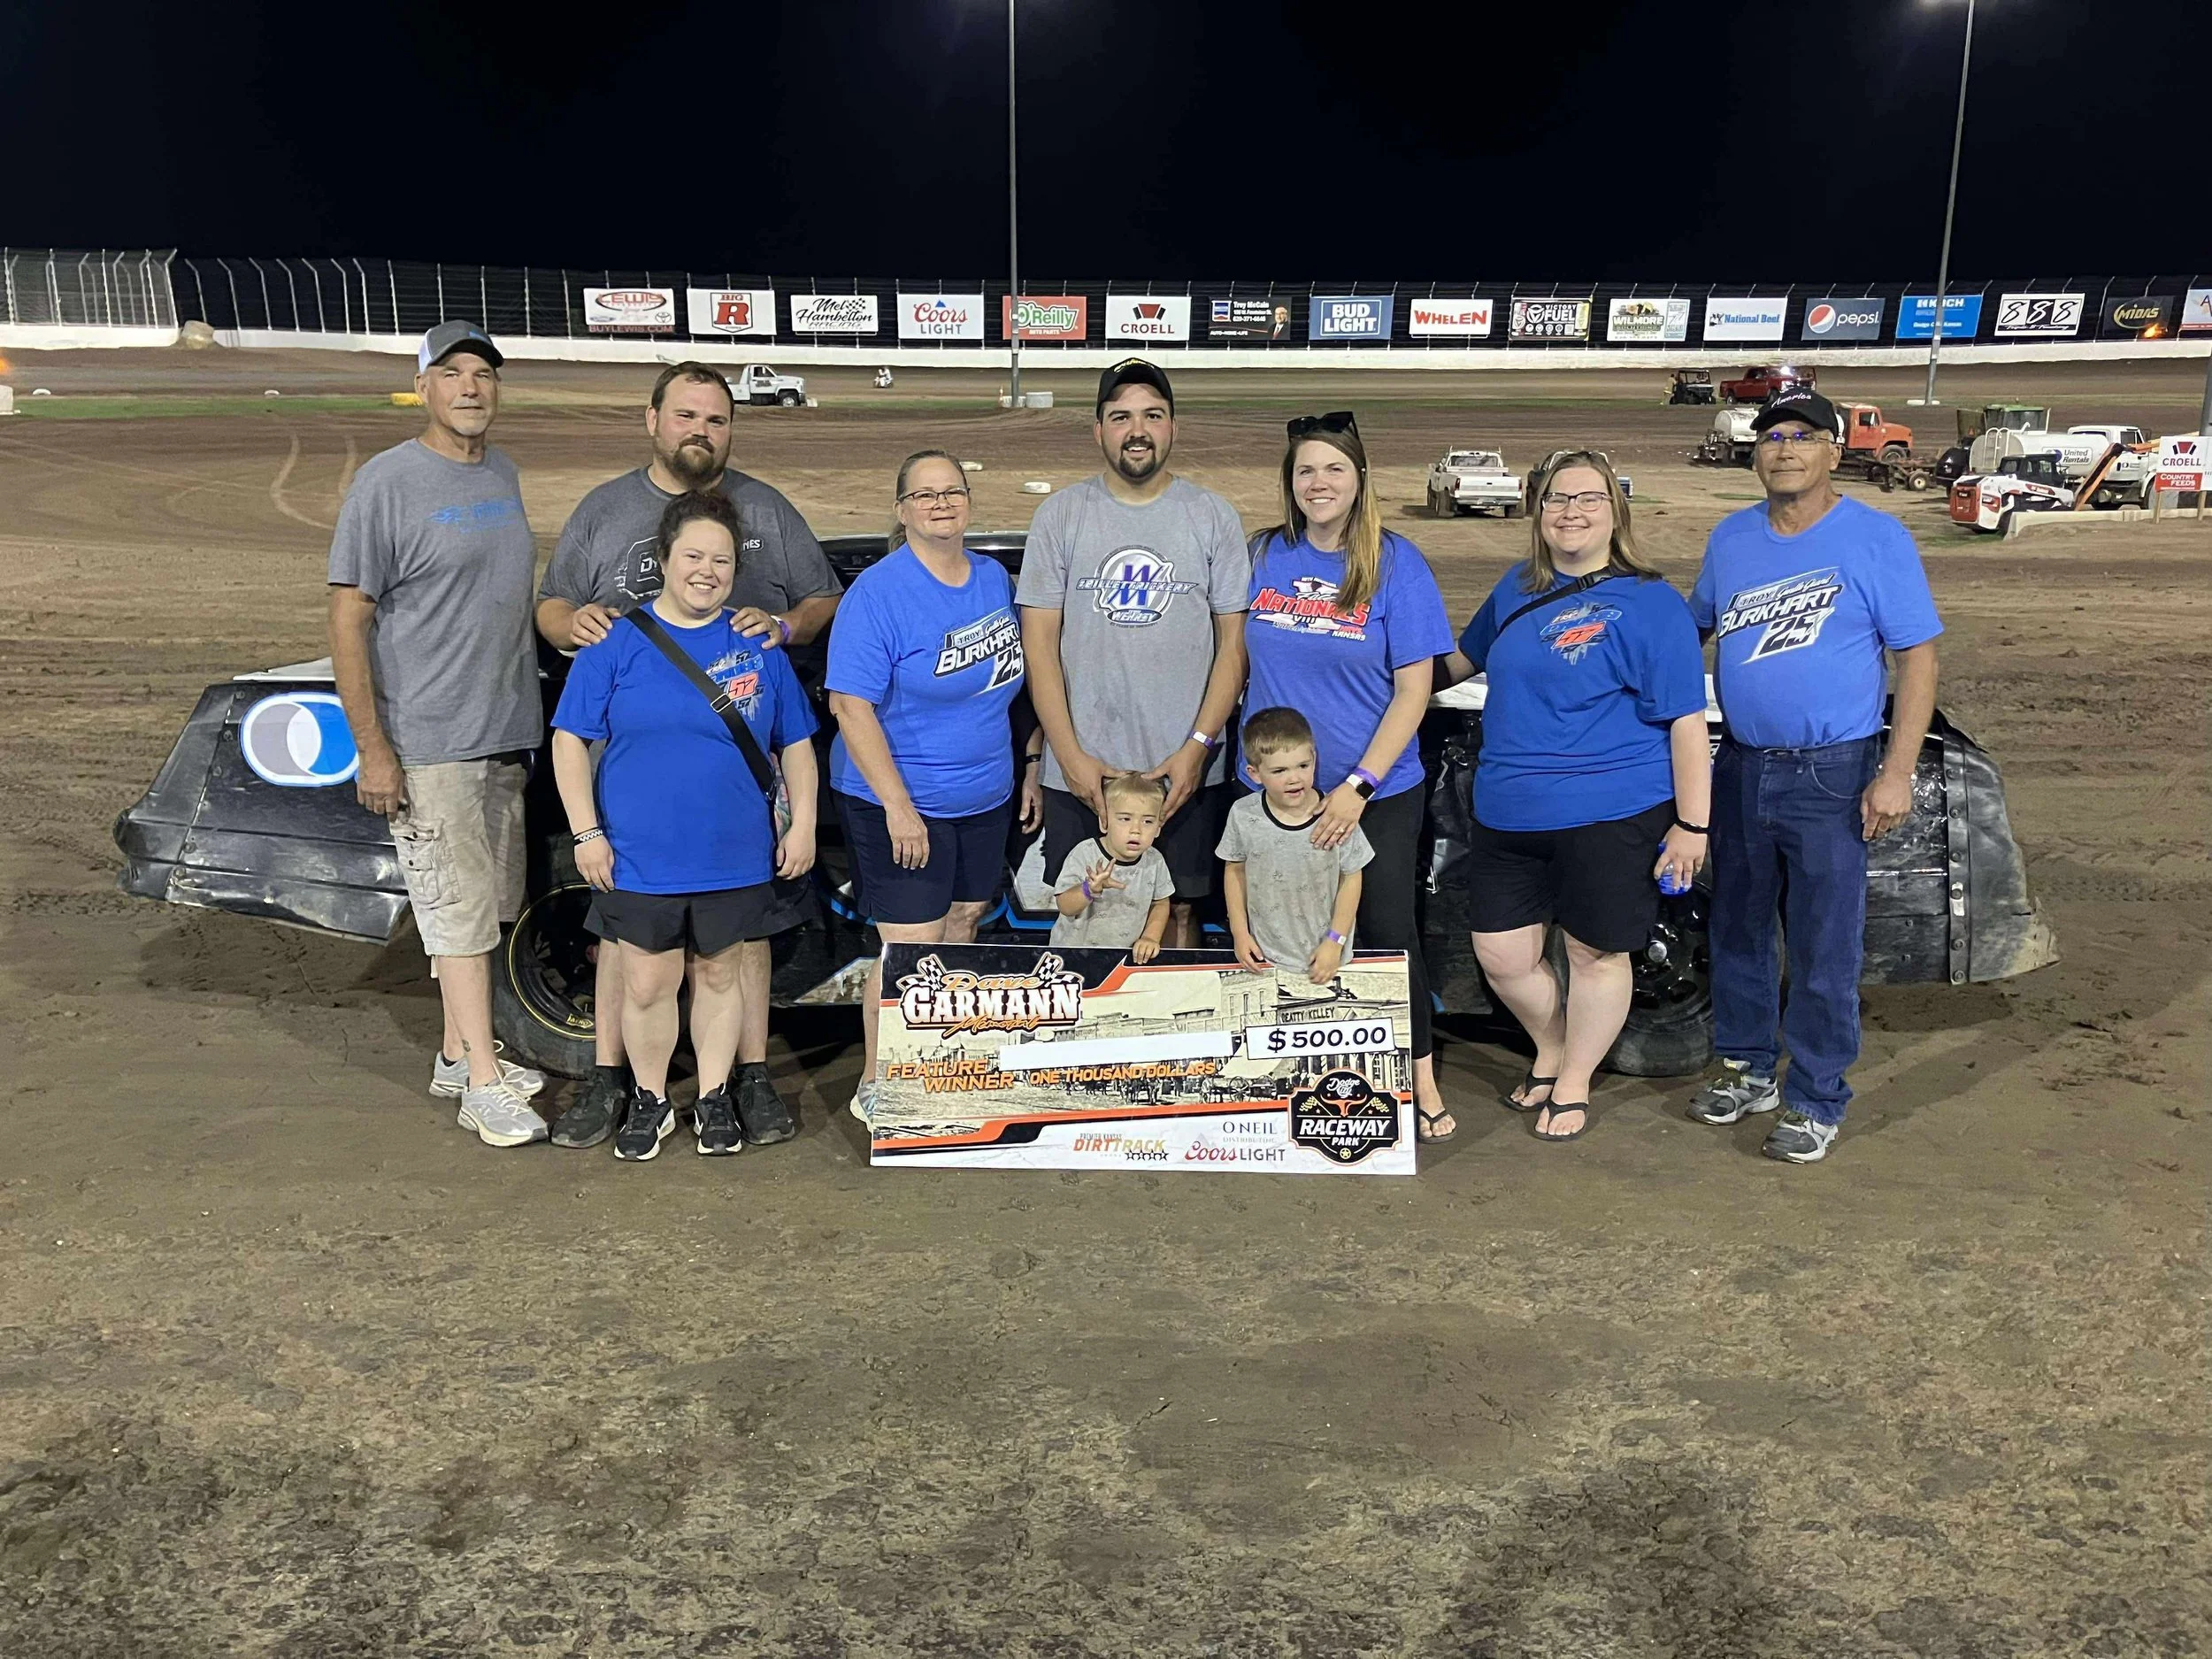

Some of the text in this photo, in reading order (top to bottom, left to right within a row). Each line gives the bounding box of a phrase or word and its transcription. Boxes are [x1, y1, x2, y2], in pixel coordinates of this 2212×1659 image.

[598, 293, 663, 303] LEWIS
[812, 298, 846, 312] Mel
[714, 302, 749, 325] R
[796, 309, 872, 323] Hambelton
[913, 303, 968, 322] Coors
[1332, 303, 1371, 319] BUD
[1414, 310, 1487, 325] WHELEN
[1544, 309, 1575, 321] FUEL
[1724, 313, 1780, 323] National Beef
[1837, 311, 1879, 326] pepsi
[1324, 318, 1377, 332] LIGHT
[1613, 315, 1664, 326] WILMORE
[920, 324, 962, 334] LIGHT
[1120, 324, 1175, 334] CROELL
[2162, 457, 2201, 466] CROELL
[1718, 586, 1839, 638] BURKHART
[1332, 631, 1366, 641] KANSAS
[933, 623, 1019, 675] BURKHART
[941, 973, 1042, 991] Dave
[902, 984, 1078, 1024] GARMANN
[1309, 1007, 1335, 1018] KELLEY
[1267, 1026, 1386, 1053] $500.00
[887, 1058, 989, 1081] FEATURE
[1030, 1063, 1216, 1085] ONE THOUSAND DOLLARS
[924, 1071, 1014, 1094] WINNER
[1326, 1078, 1360, 1091] Dodge
[1299, 1119, 1390, 1136] RACEWAY
[1332, 1137, 1360, 1146] PARK
[1185, 1141, 1285, 1161] Coors LIGHT
